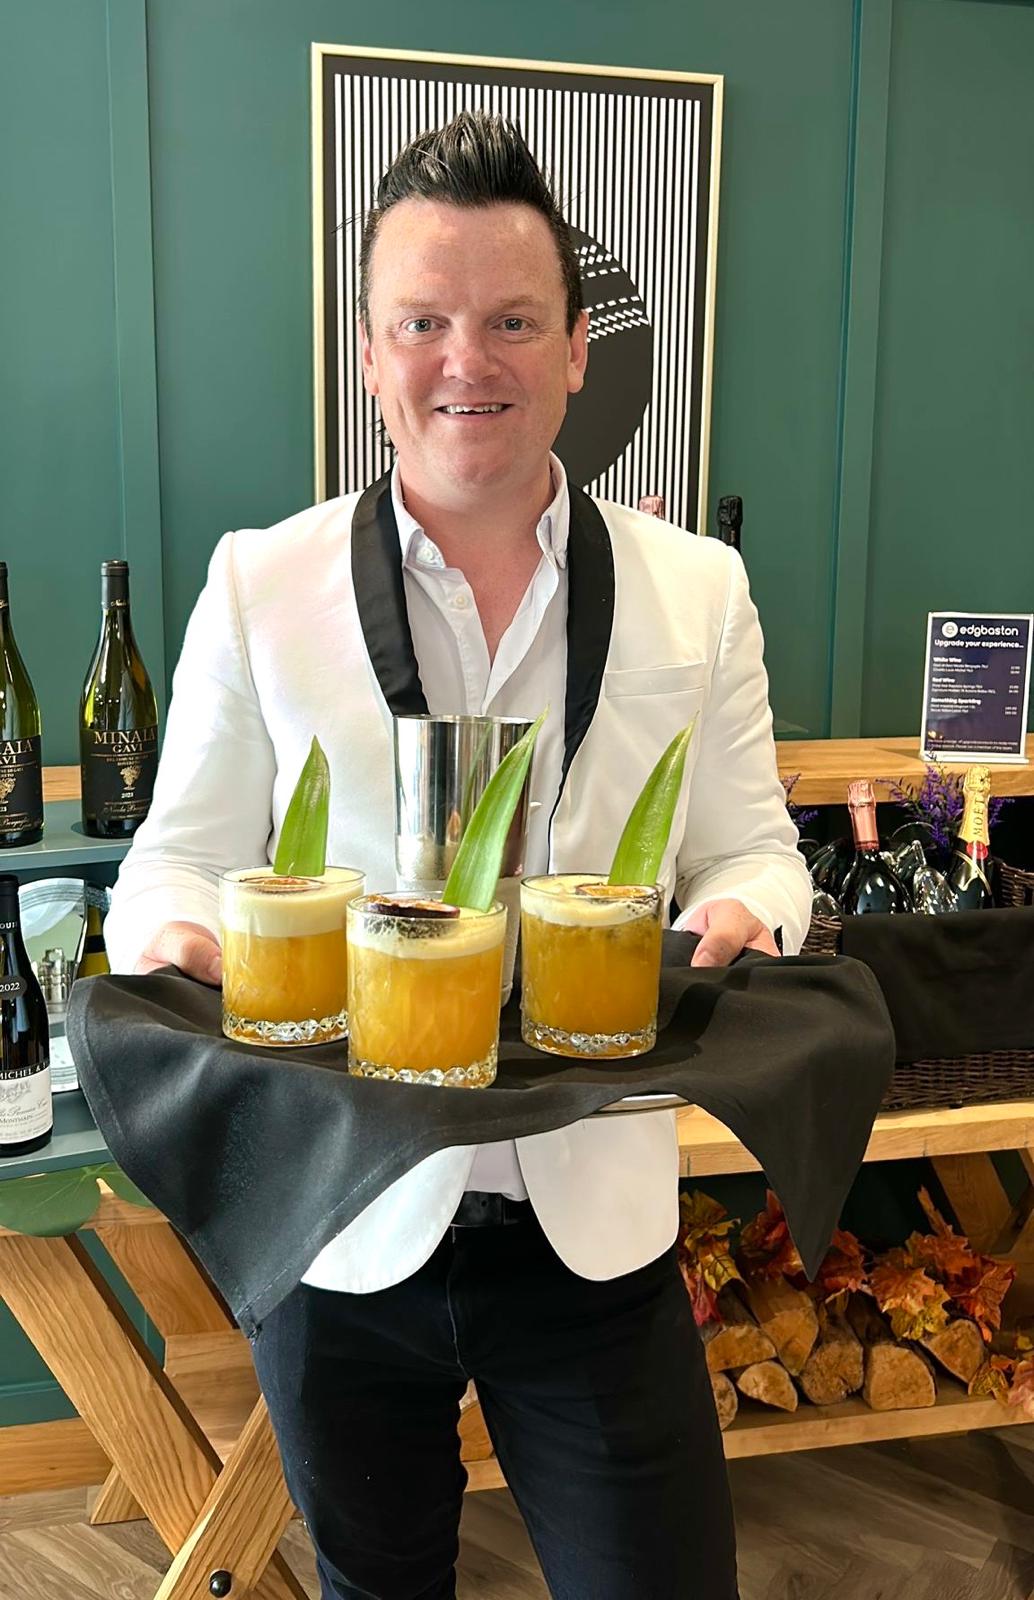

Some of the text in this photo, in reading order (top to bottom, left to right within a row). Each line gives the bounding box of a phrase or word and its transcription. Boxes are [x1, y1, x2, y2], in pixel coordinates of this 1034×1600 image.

[960, 625, 1018, 637] edgbaston
[934, 639, 964, 648] Upgrade
[0, 739, 33, 755] AIA
[112, 743, 143, 753] GAVI
[0, 981, 20, 992] 2022
